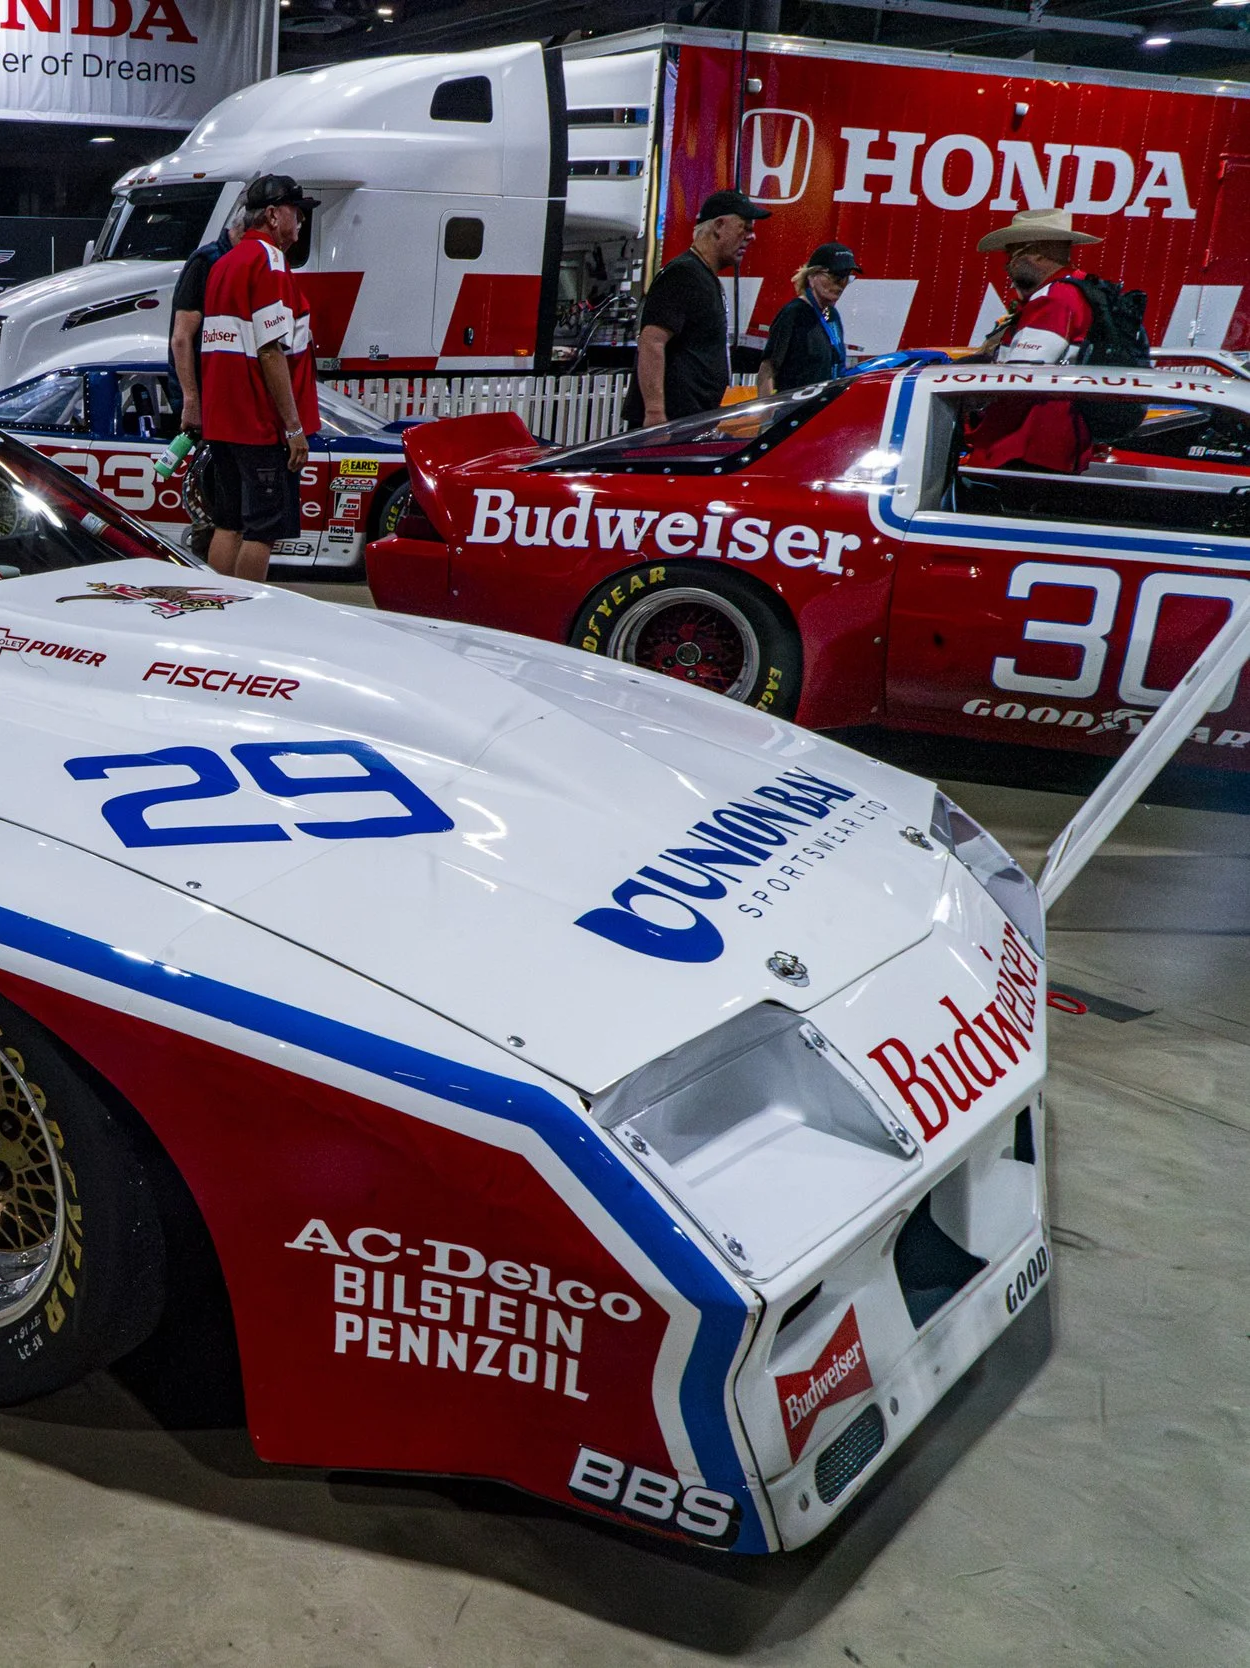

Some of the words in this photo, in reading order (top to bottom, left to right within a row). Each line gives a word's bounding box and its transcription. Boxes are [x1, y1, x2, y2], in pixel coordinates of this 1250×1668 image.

[41, 51, 73, 76] of
[82, 54, 196, 85] Dreams
[834, 127, 1198, 220] HONDA
[933, 372, 1034, 384] JOHN
[1167, 380, 1226, 394] JR.
[350, 461, 378, 471] EARL'S
[330, 526, 354, 536] Holley
[466, 487, 861, 576] Budweiser
[25, 639, 108, 668] POWER
[142, 660, 301, 701] FISCHER
[991, 560, 1250, 714] 30
[63, 740, 456, 848] 29
[738, 817, 865, 919] SPORTSWEAR
[862, 799, 888, 821] LTD
[866, 921, 1038, 1144] Budweiser
[284, 1218, 643, 1323] AC-Delco
[334, 1263, 584, 1354] BILSTEIN
[1005, 1245, 1048, 1315] GOOD
[334, 1311, 590, 1402] PENNZOIL
[784, 1337, 863, 1431] Budweiser
[567, 1445, 736, 1538] BBS
